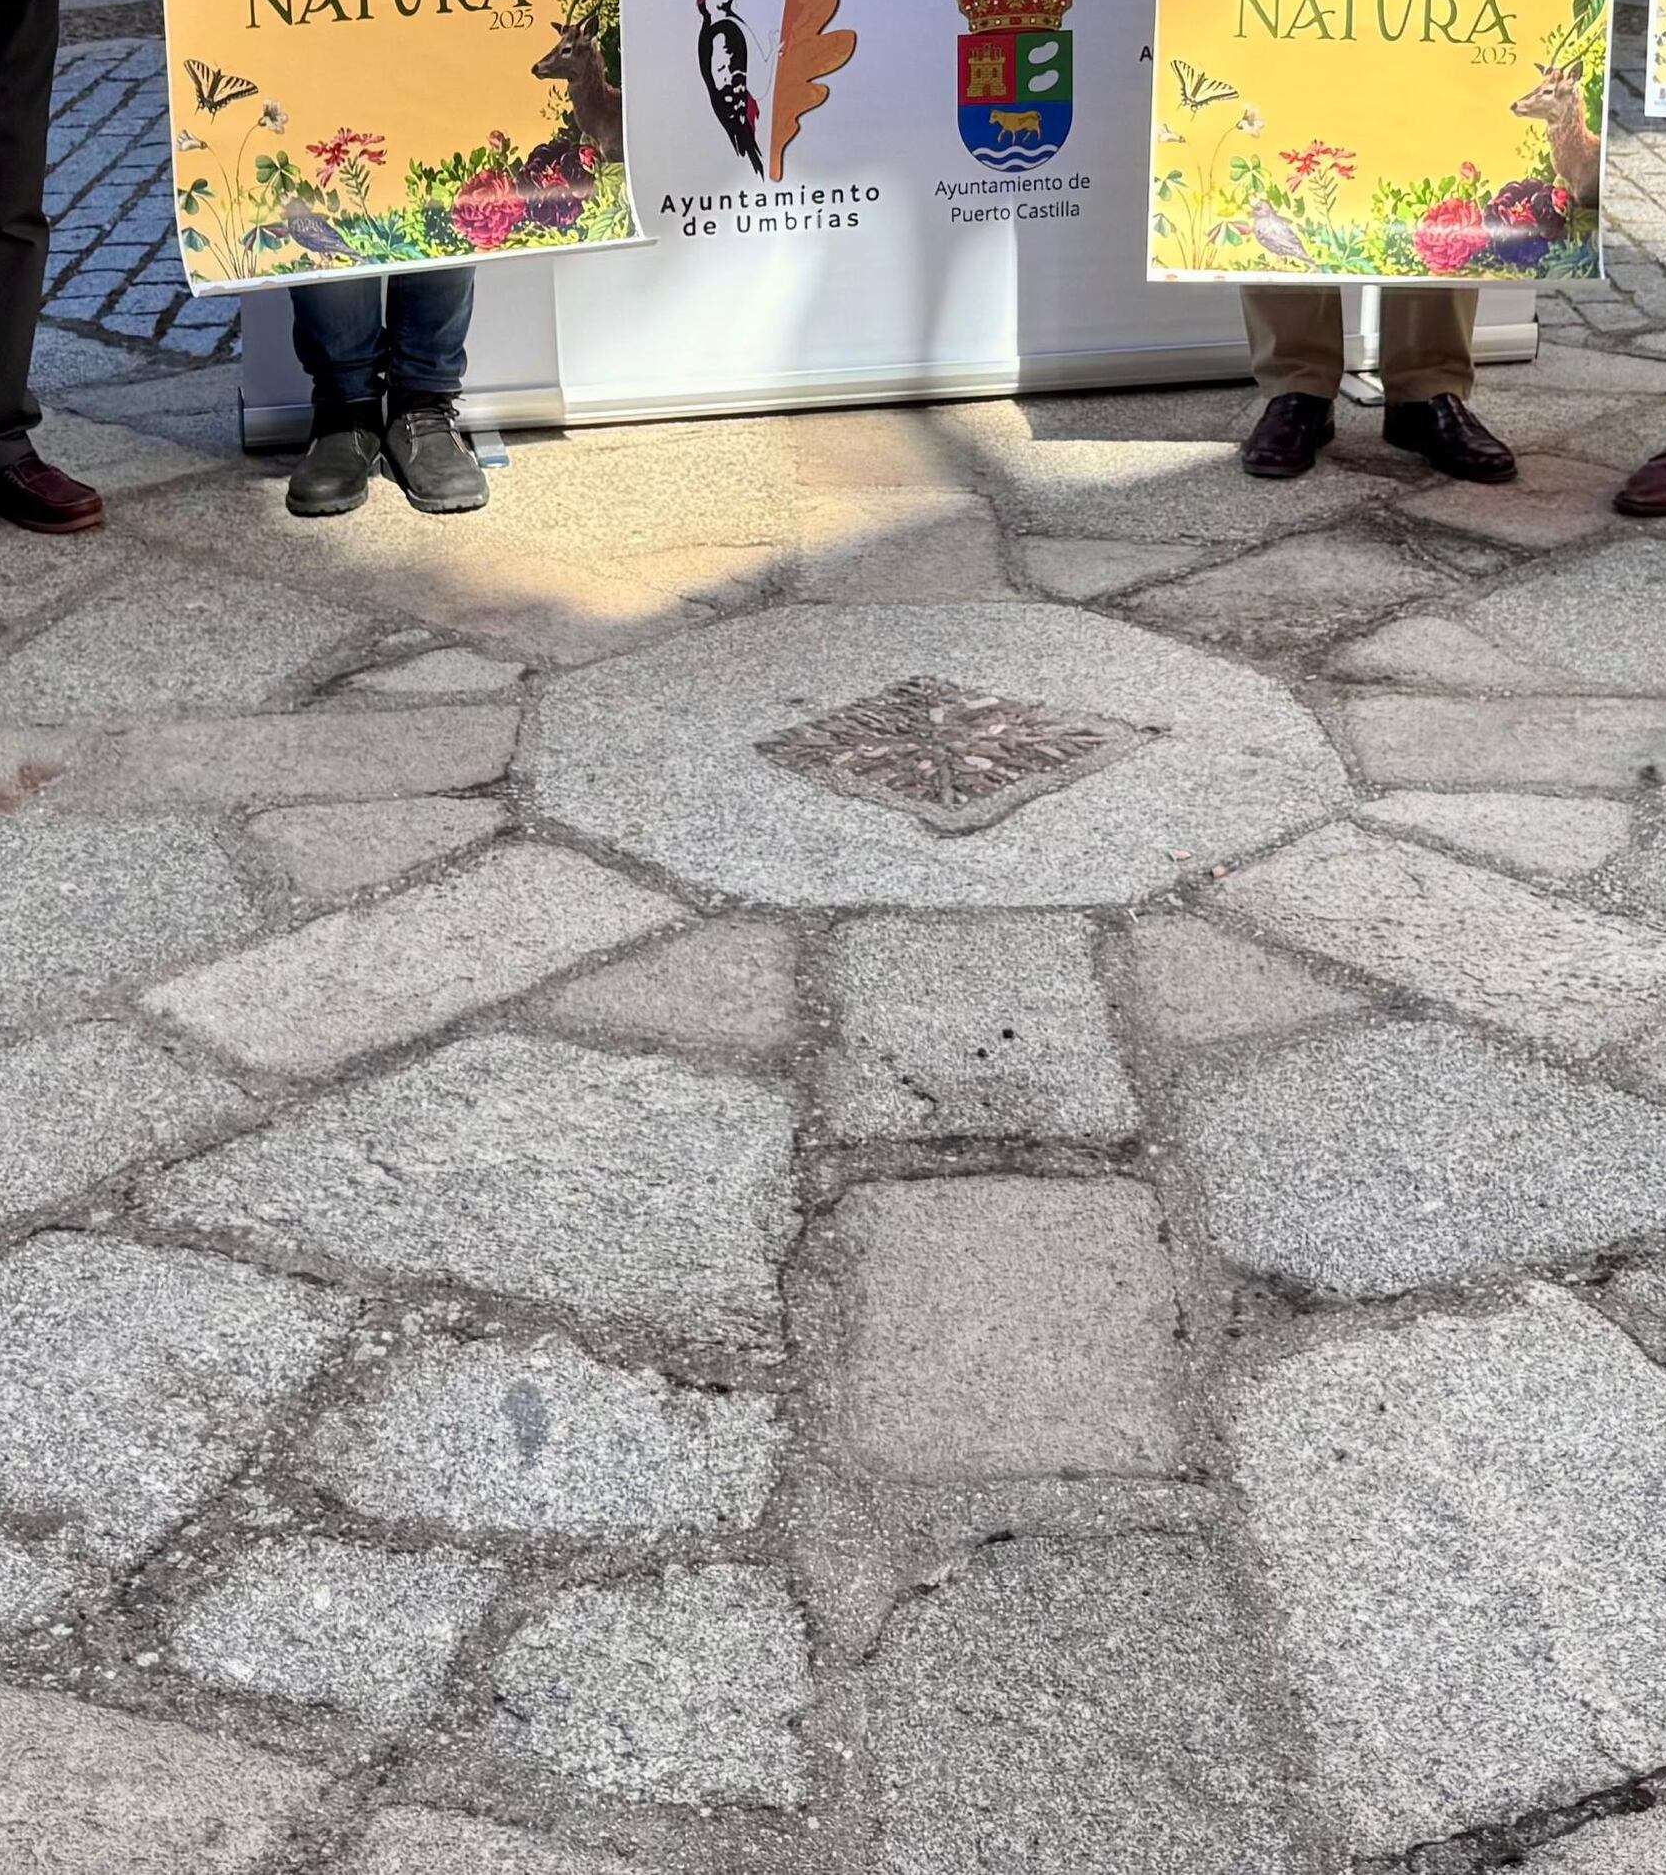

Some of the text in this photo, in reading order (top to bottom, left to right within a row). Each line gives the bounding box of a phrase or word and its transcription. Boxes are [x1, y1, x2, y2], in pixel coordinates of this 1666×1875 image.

[489, 9, 534, 31] 2025
[1470, 45, 1517, 66] 2025
[934, 173, 1092, 199] Ayuntamiento de
[660, 183, 882, 215] Ayuntamiento
[950, 199, 1081, 223] Puerto Castilla
[682, 209, 860, 237] de Umbrías
